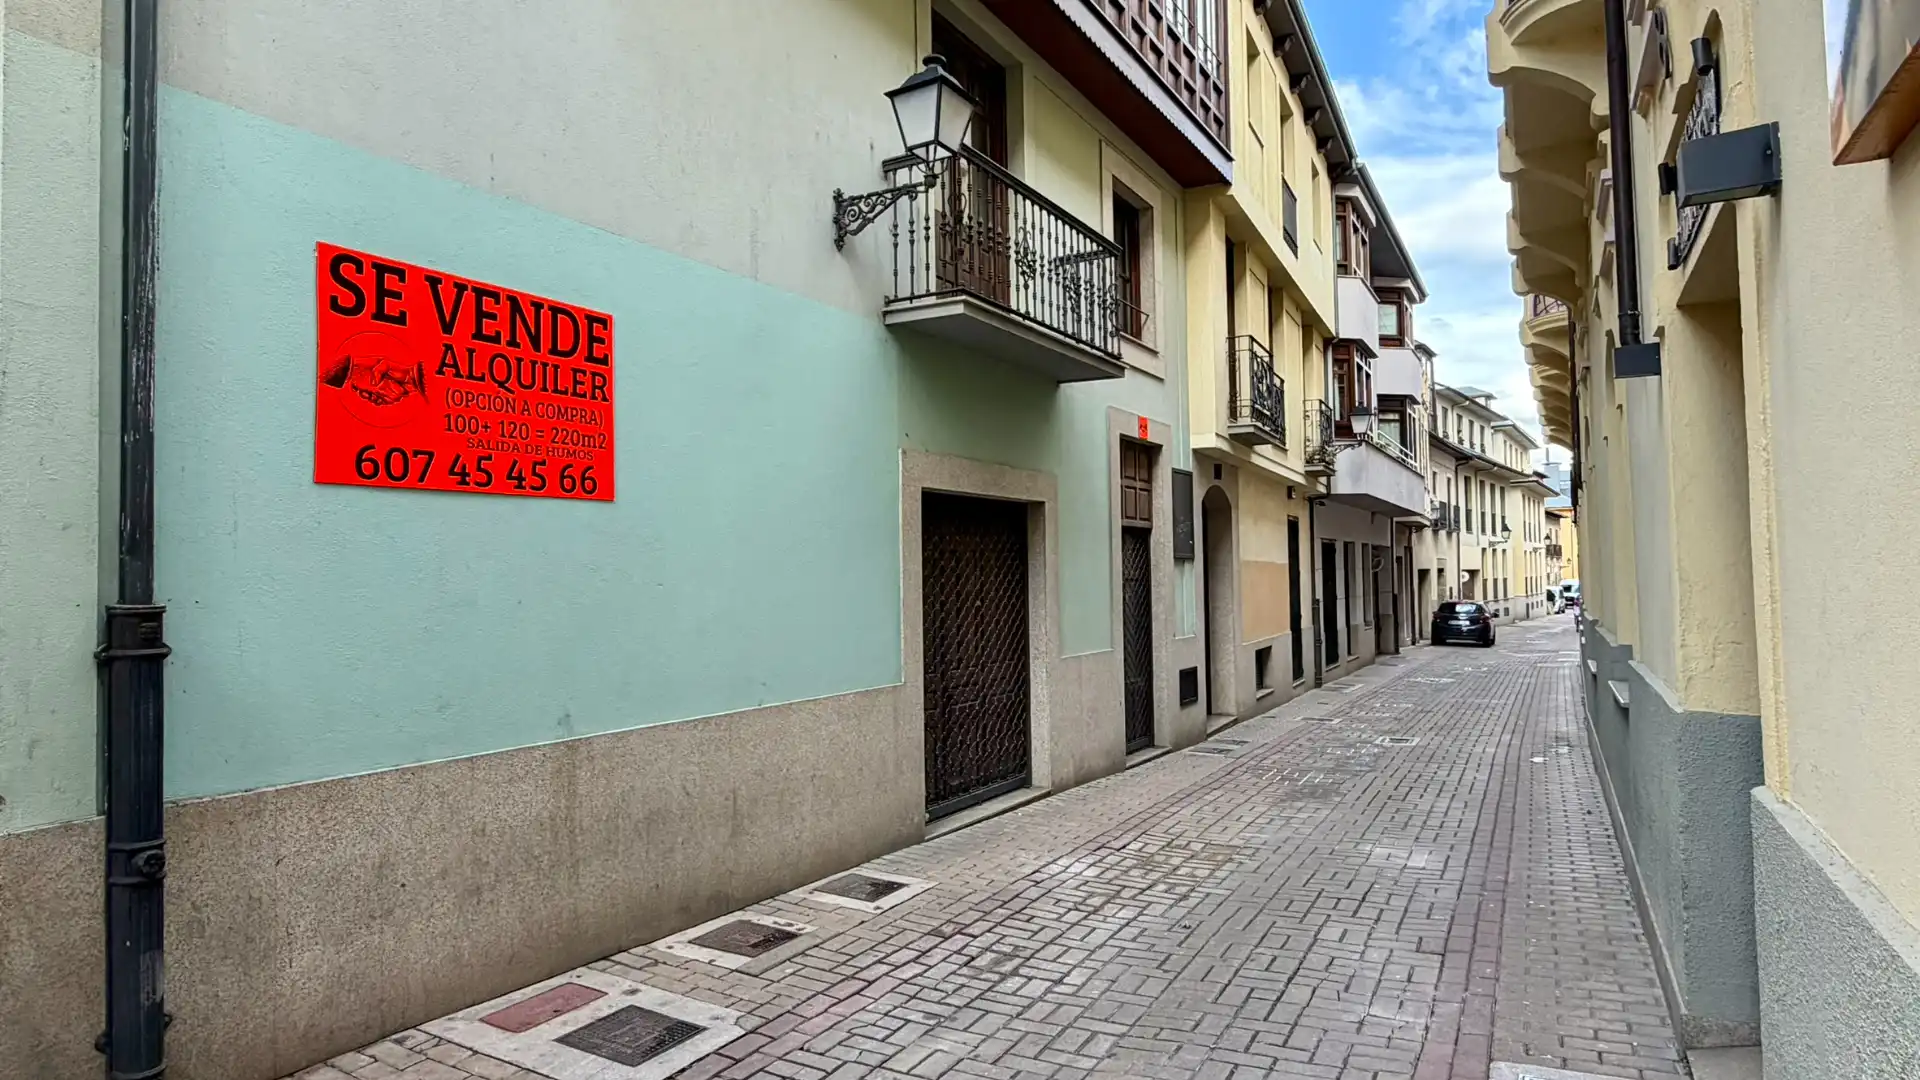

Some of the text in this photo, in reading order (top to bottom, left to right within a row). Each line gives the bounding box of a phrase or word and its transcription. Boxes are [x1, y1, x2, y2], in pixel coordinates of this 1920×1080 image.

[330, 252, 610, 367] SE VENDE
[435, 343, 610, 402] ALQUILER
[443, 413, 607, 450] 100+ 120 = 220m2
[520, 400, 532, 416] A
[535, 402, 604, 428] COMPRA)
[354, 445, 598, 495] 607 45 45 66
[466, 438, 594, 461] SALIDA DE HUMOS
